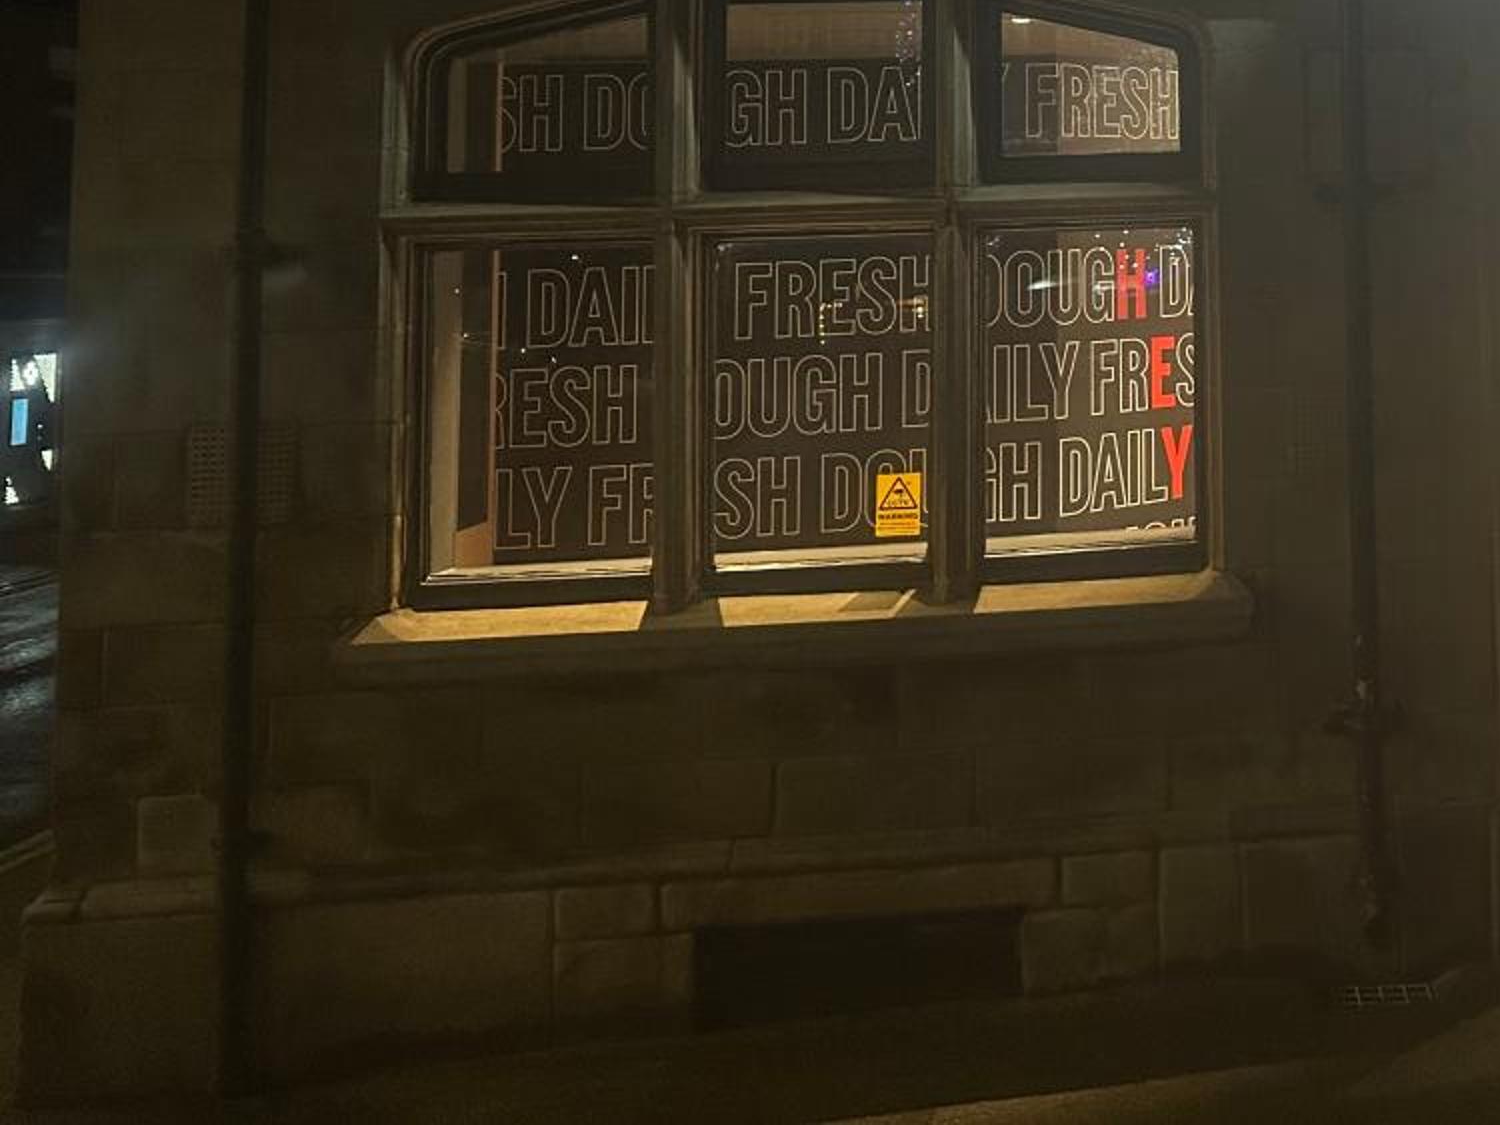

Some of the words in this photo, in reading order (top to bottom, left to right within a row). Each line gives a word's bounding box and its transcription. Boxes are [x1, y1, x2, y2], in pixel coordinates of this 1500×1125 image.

[1025, 62, 1180, 140] FRESH
[734, 256, 930, 340] FRESH
[496, 364, 637, 449] ESH
[714, 351, 882, 440] OUGH
[1059, 425, 1193, 518] DAILY
